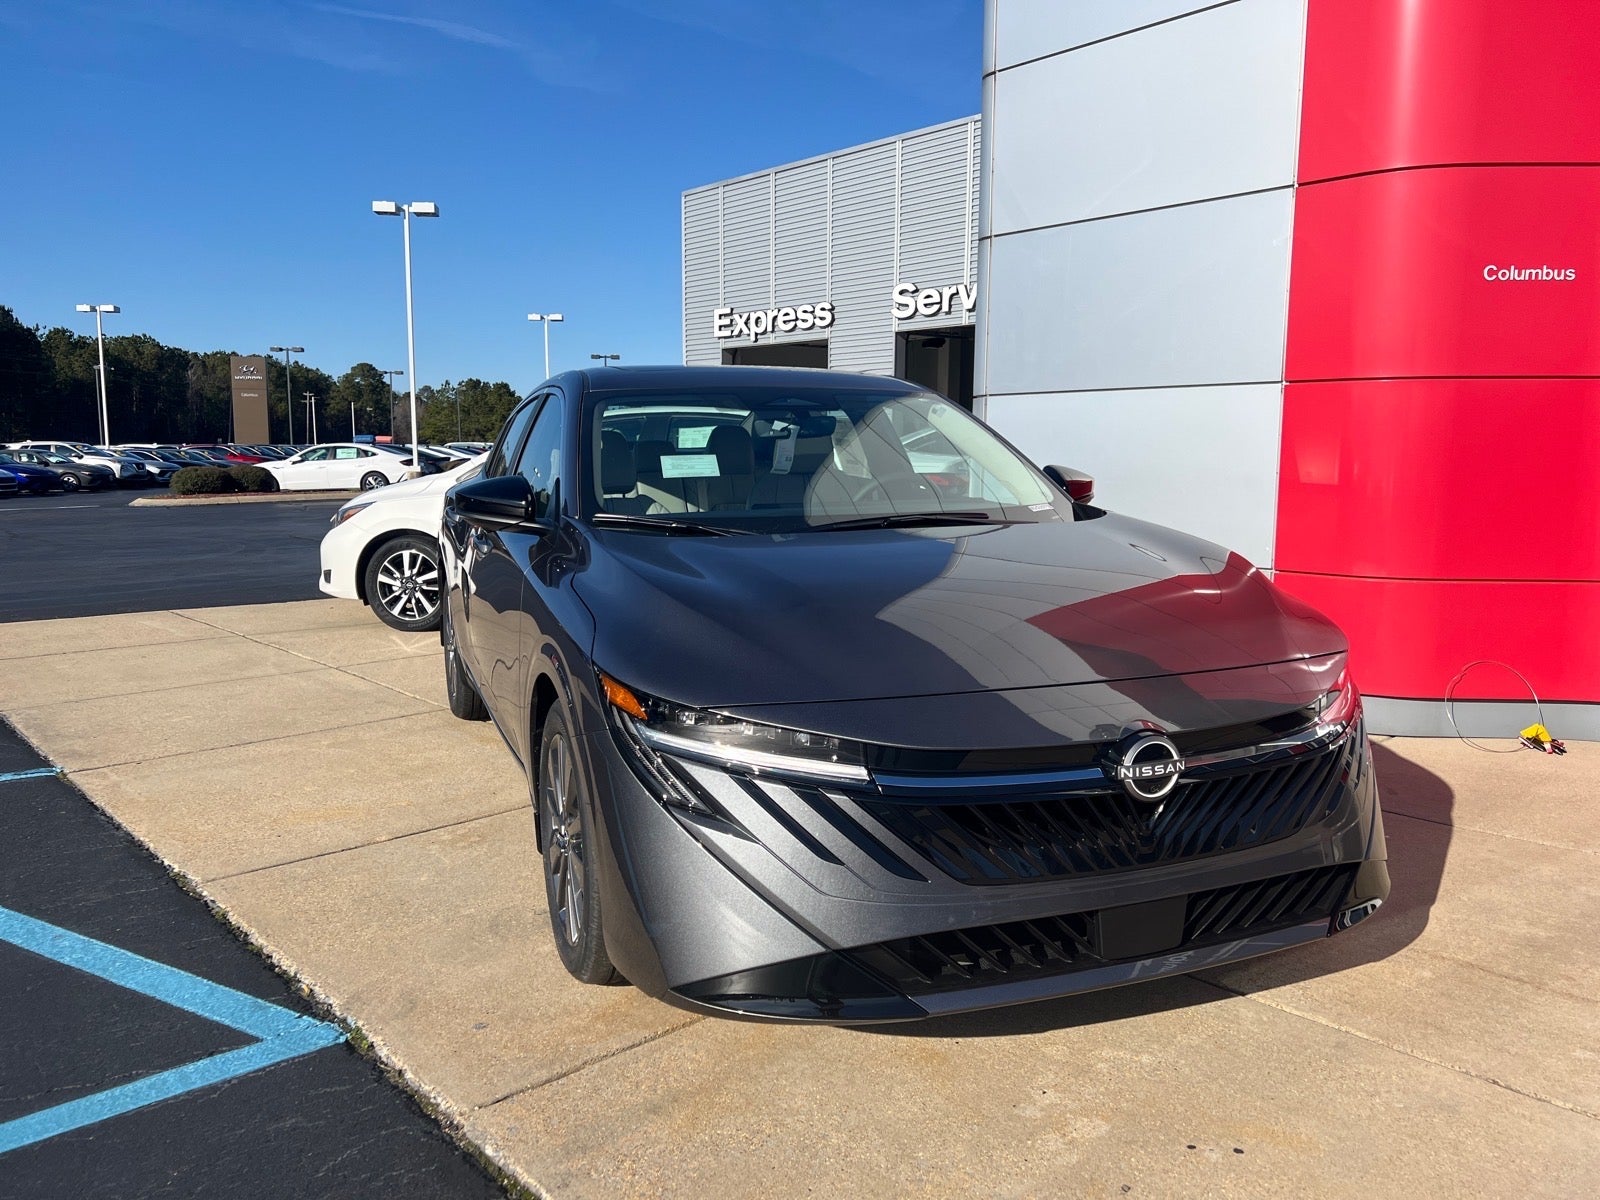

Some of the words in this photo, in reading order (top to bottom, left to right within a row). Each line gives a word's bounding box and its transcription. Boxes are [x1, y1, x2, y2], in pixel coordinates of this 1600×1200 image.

[1483, 264, 1576, 281] Columbus
[713, 301, 834, 342] Express
[890, 282, 978, 319] Serv
[1120, 760, 1185, 778] NISSAN
